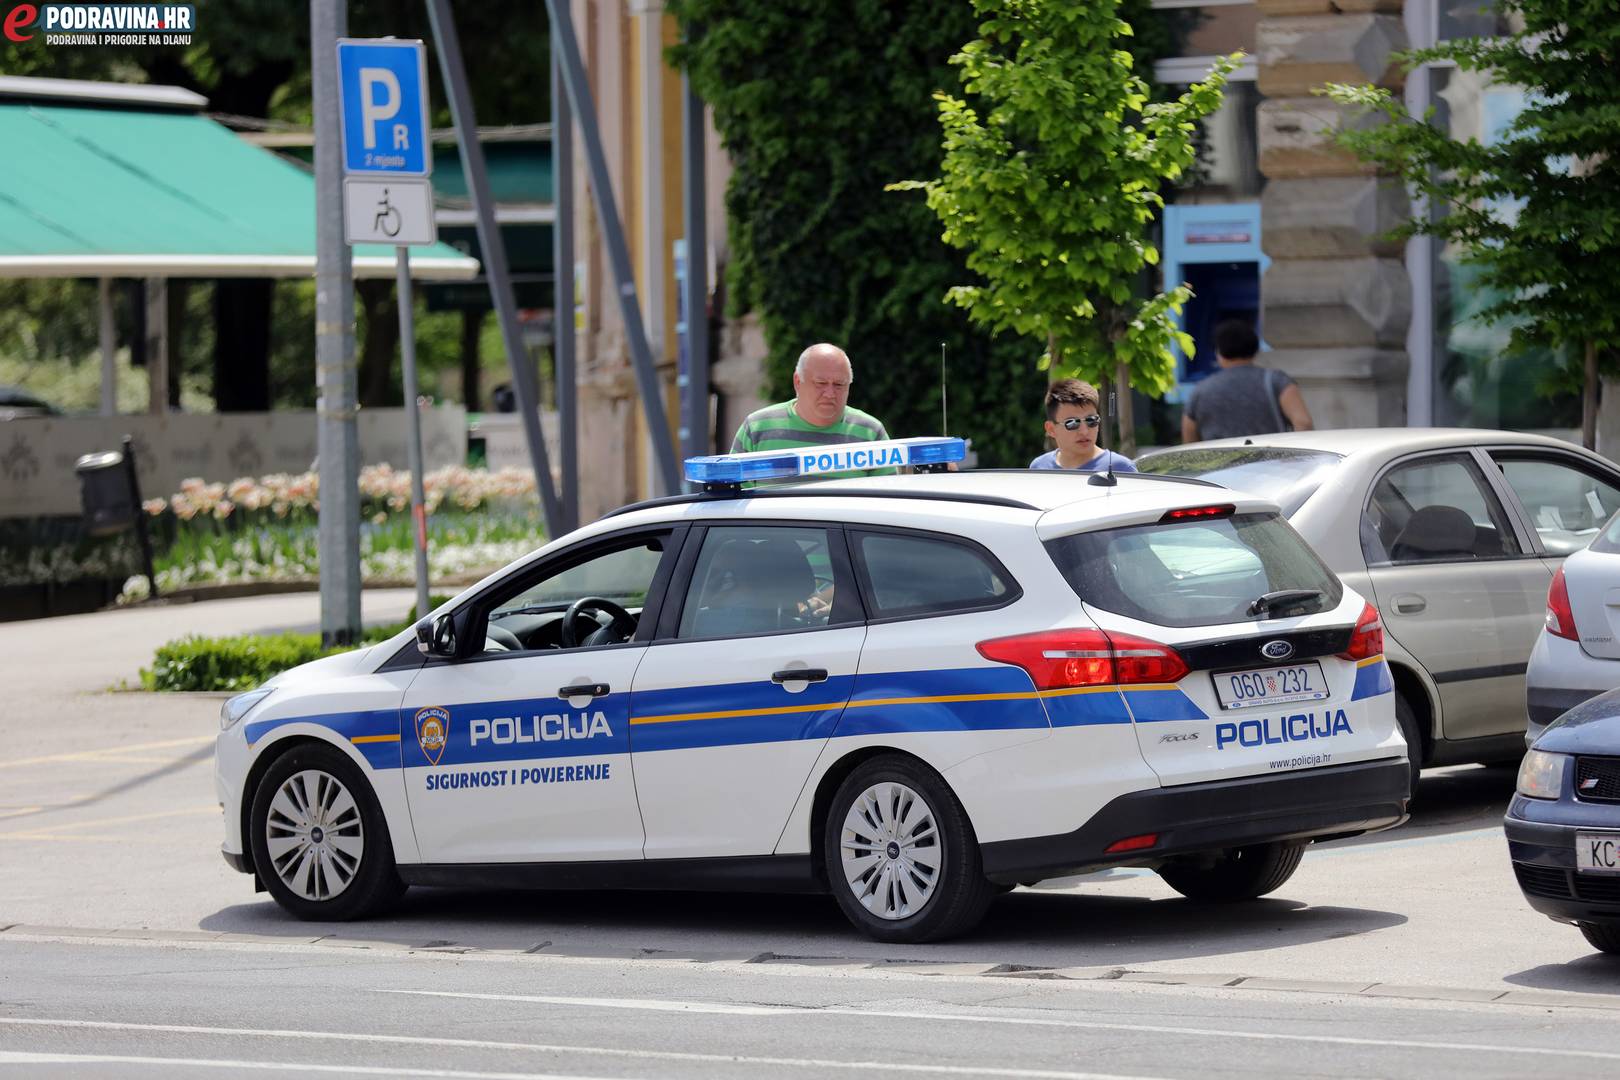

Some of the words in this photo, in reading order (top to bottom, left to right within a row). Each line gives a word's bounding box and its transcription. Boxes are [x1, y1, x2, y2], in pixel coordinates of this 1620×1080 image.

[359, 67, 401, 149] P
[392, 123, 409, 150] R
[803, 447, 904, 473] POLICIJA
[1230, 672, 1267, 700] 060
[1277, 668, 1313, 694] 232
[417, 709, 448, 722] POLICIJA
[469, 711, 614, 747] POLICIJA
[1215, 709, 1353, 750] POLICIJA
[1269, 752, 1332, 769] www.policija.hr
[426, 770, 508, 791] SIGURNOST
[511, 773, 516, 785] I
[520, 763, 610, 785] POVJERENJE
[1591, 841, 1616, 868] KC
